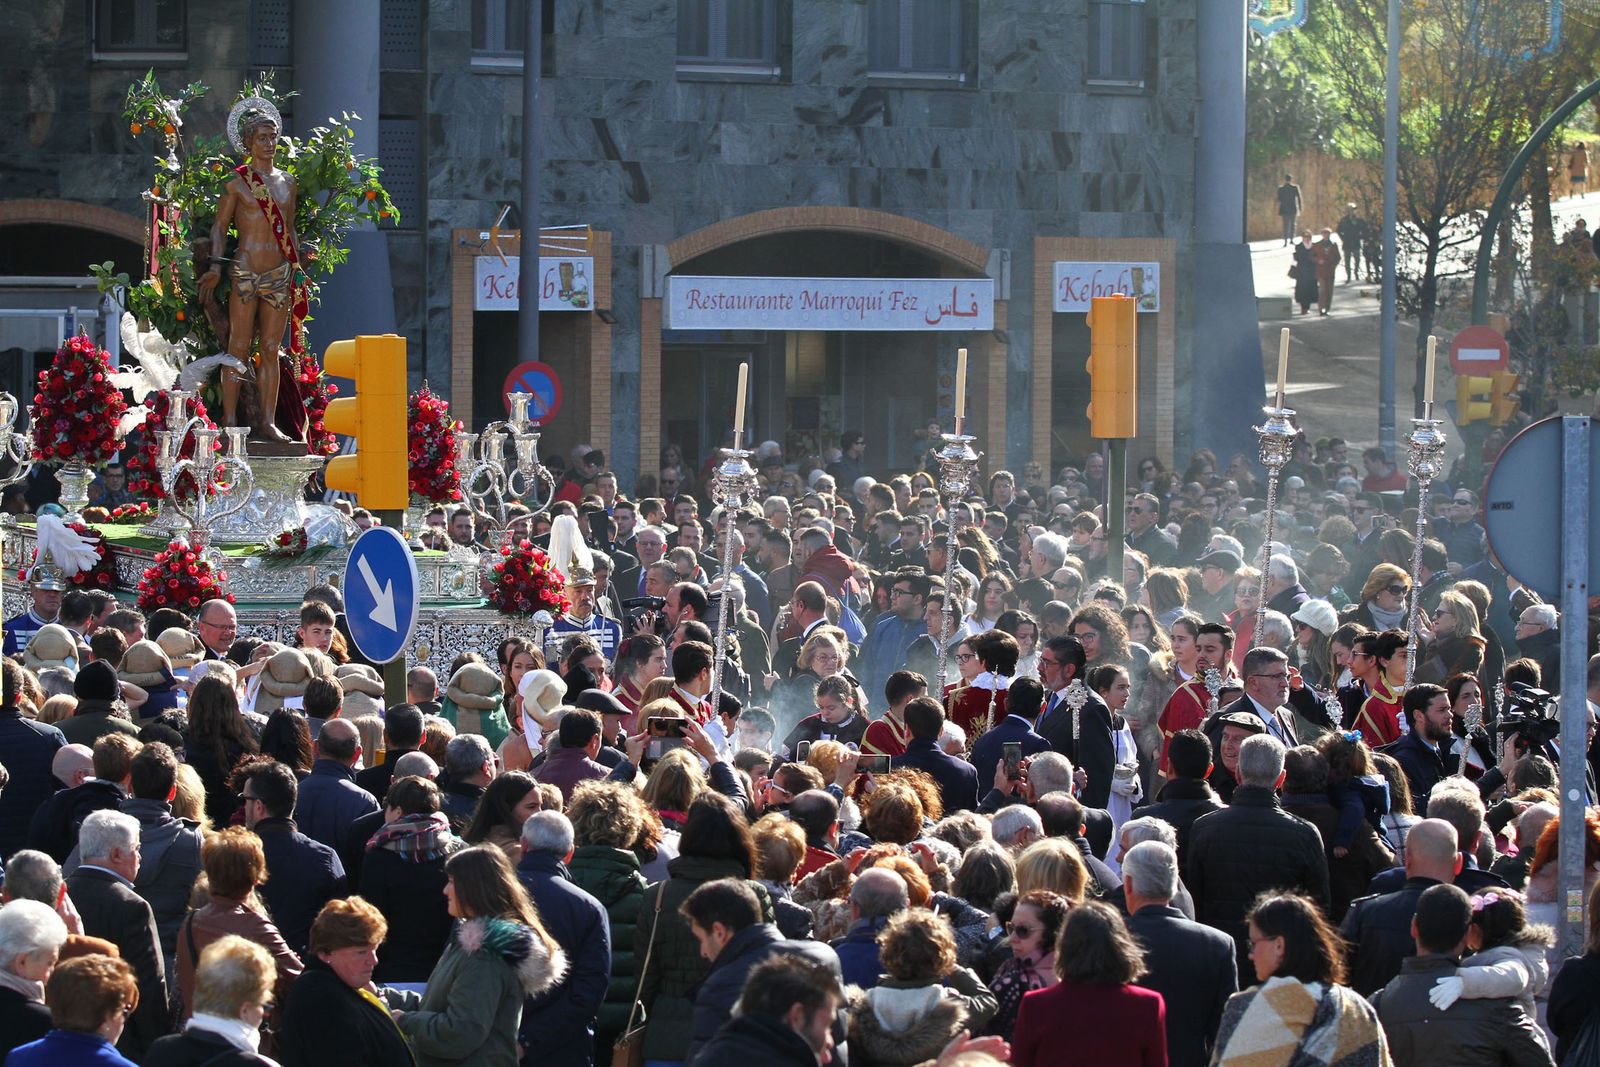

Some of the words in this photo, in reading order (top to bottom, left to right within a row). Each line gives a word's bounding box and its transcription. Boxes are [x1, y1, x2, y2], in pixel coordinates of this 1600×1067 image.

[483, 267, 556, 300] Keb
[1059, 268, 1129, 302] Kebab
[686, 289, 794, 311] Restaurante
[799, 289, 884, 321] Marroquí
[888, 290, 919, 311] Fez
[925, 285, 978, 326] فاس
